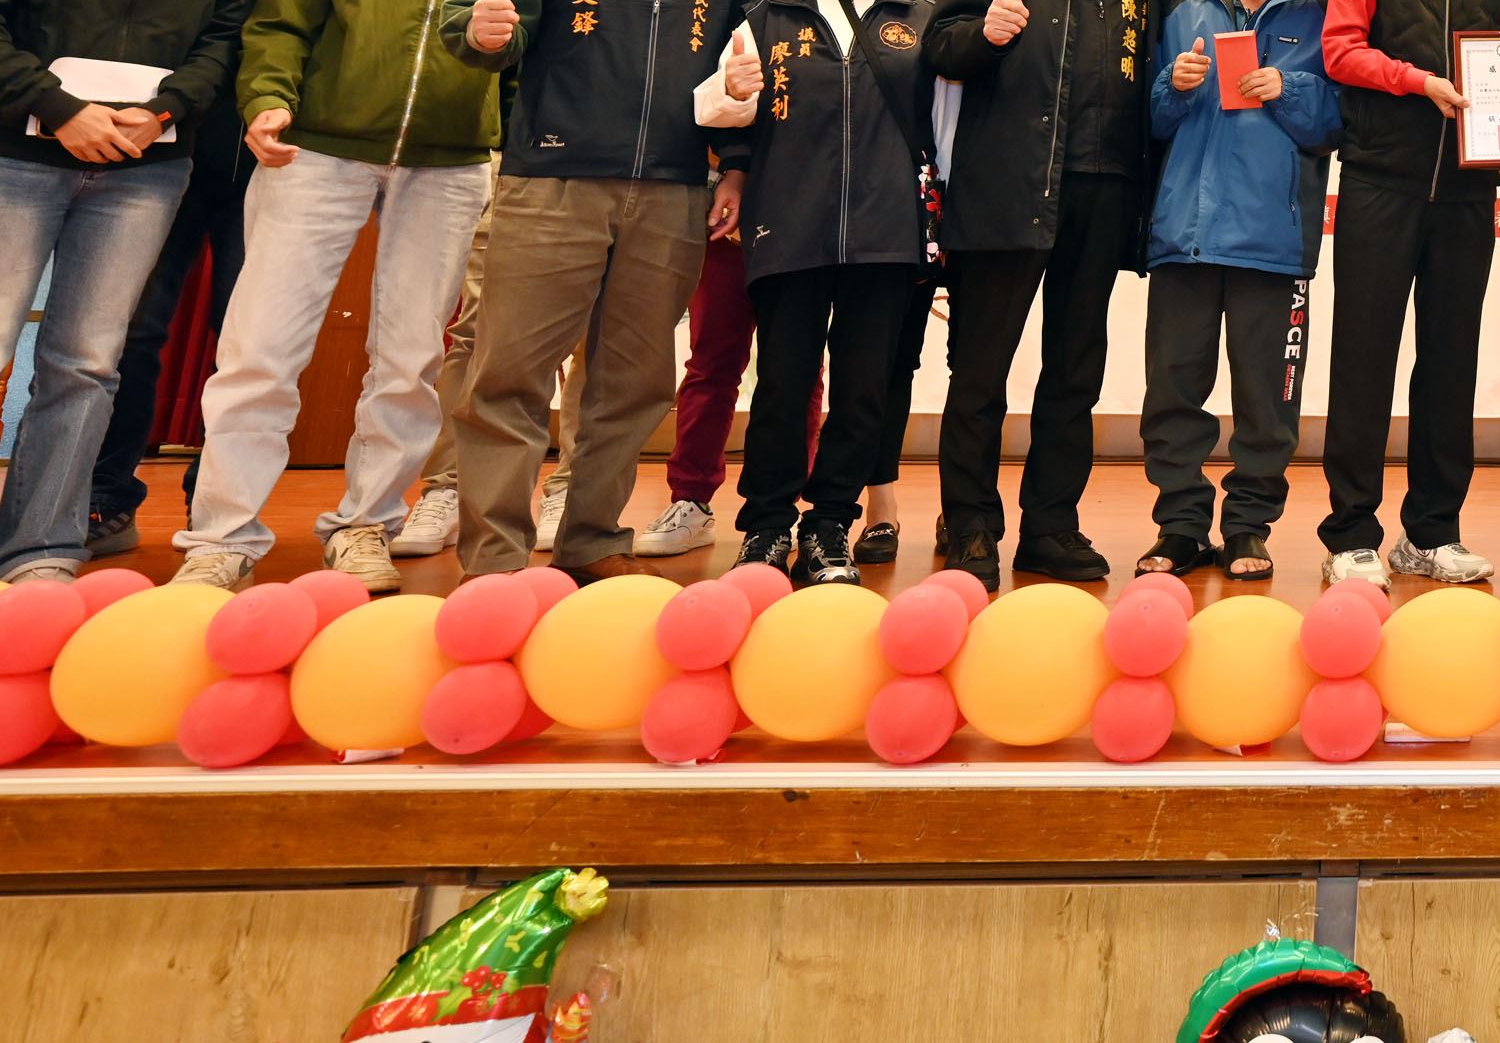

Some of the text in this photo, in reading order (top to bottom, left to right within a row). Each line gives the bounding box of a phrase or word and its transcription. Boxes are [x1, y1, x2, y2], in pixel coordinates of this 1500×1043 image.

[769, 41, 793, 121] 廖英利
[1284, 279, 1307, 359] PASCE
